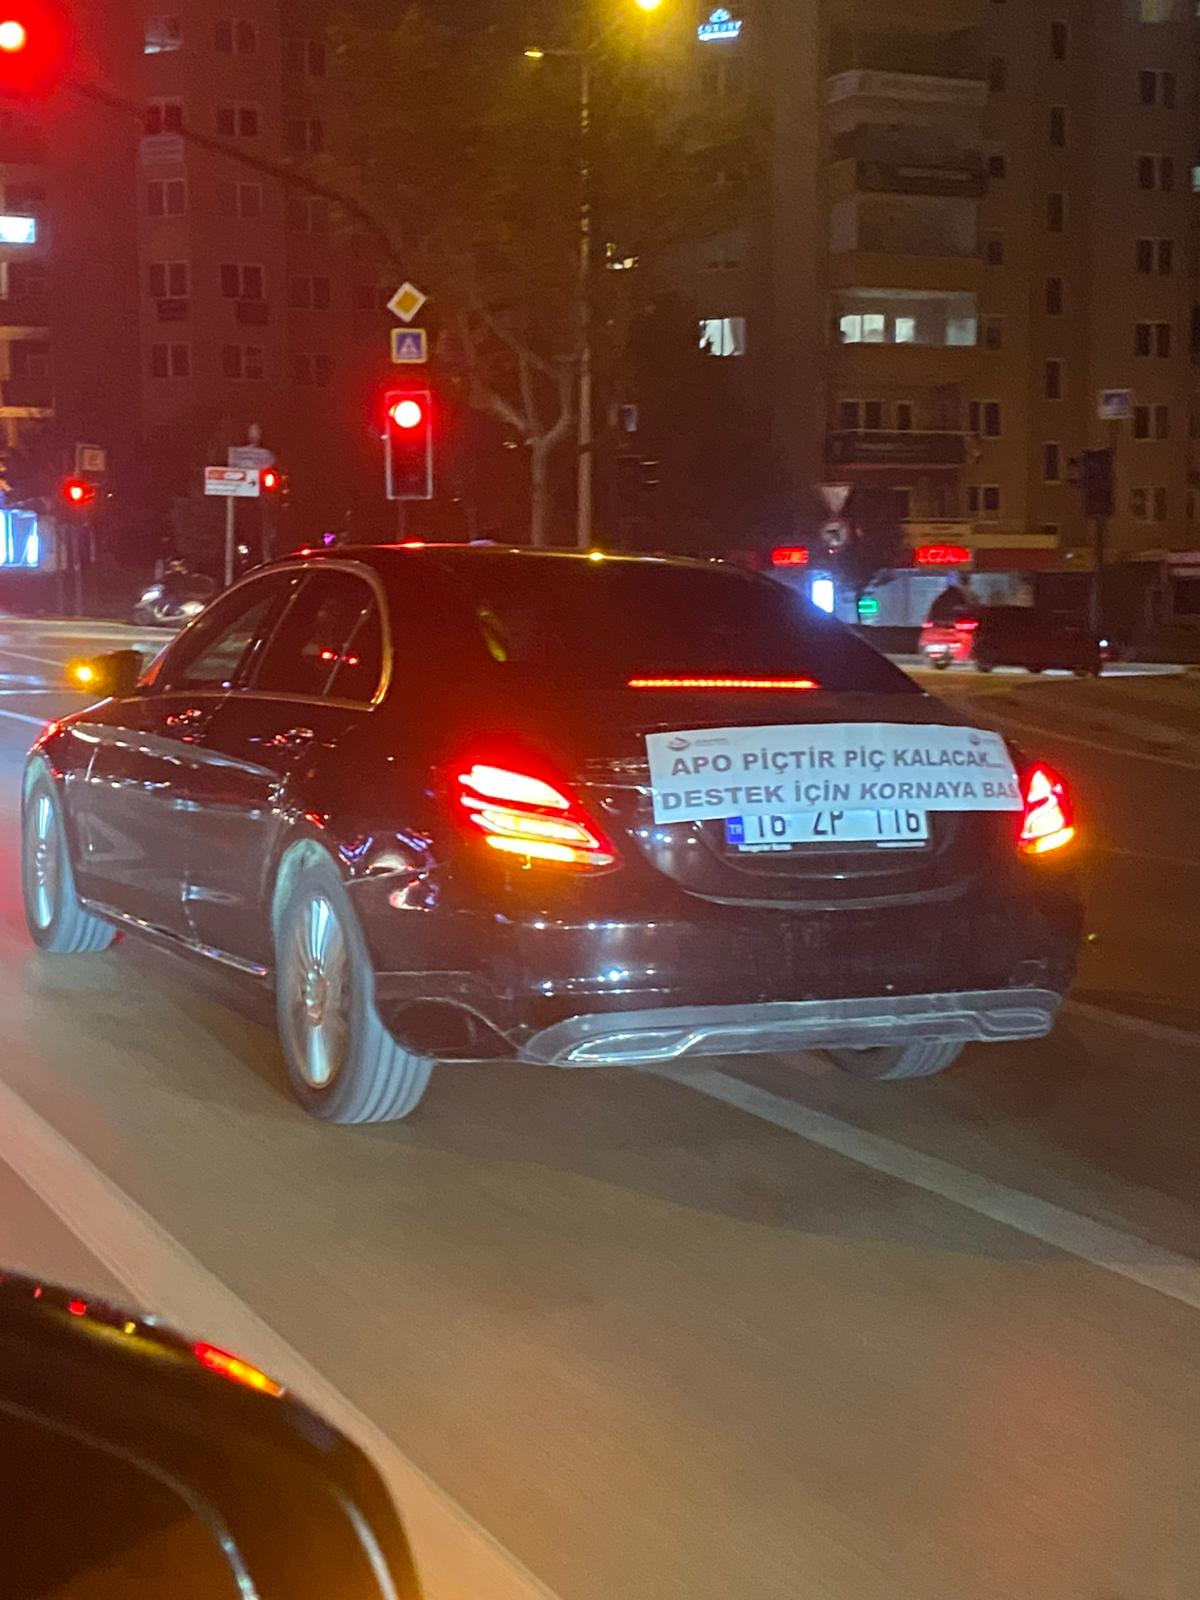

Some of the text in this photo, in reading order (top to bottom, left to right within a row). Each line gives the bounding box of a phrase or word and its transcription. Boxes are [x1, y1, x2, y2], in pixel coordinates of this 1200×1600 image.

[671, 746, 988, 777] APO PİÇTİR PİÇ KALACAK
[662, 784, 784, 810] DESTEK
[794, 779, 850, 806] İÇİN
[860, 781, 977, 800] KORNAYA
